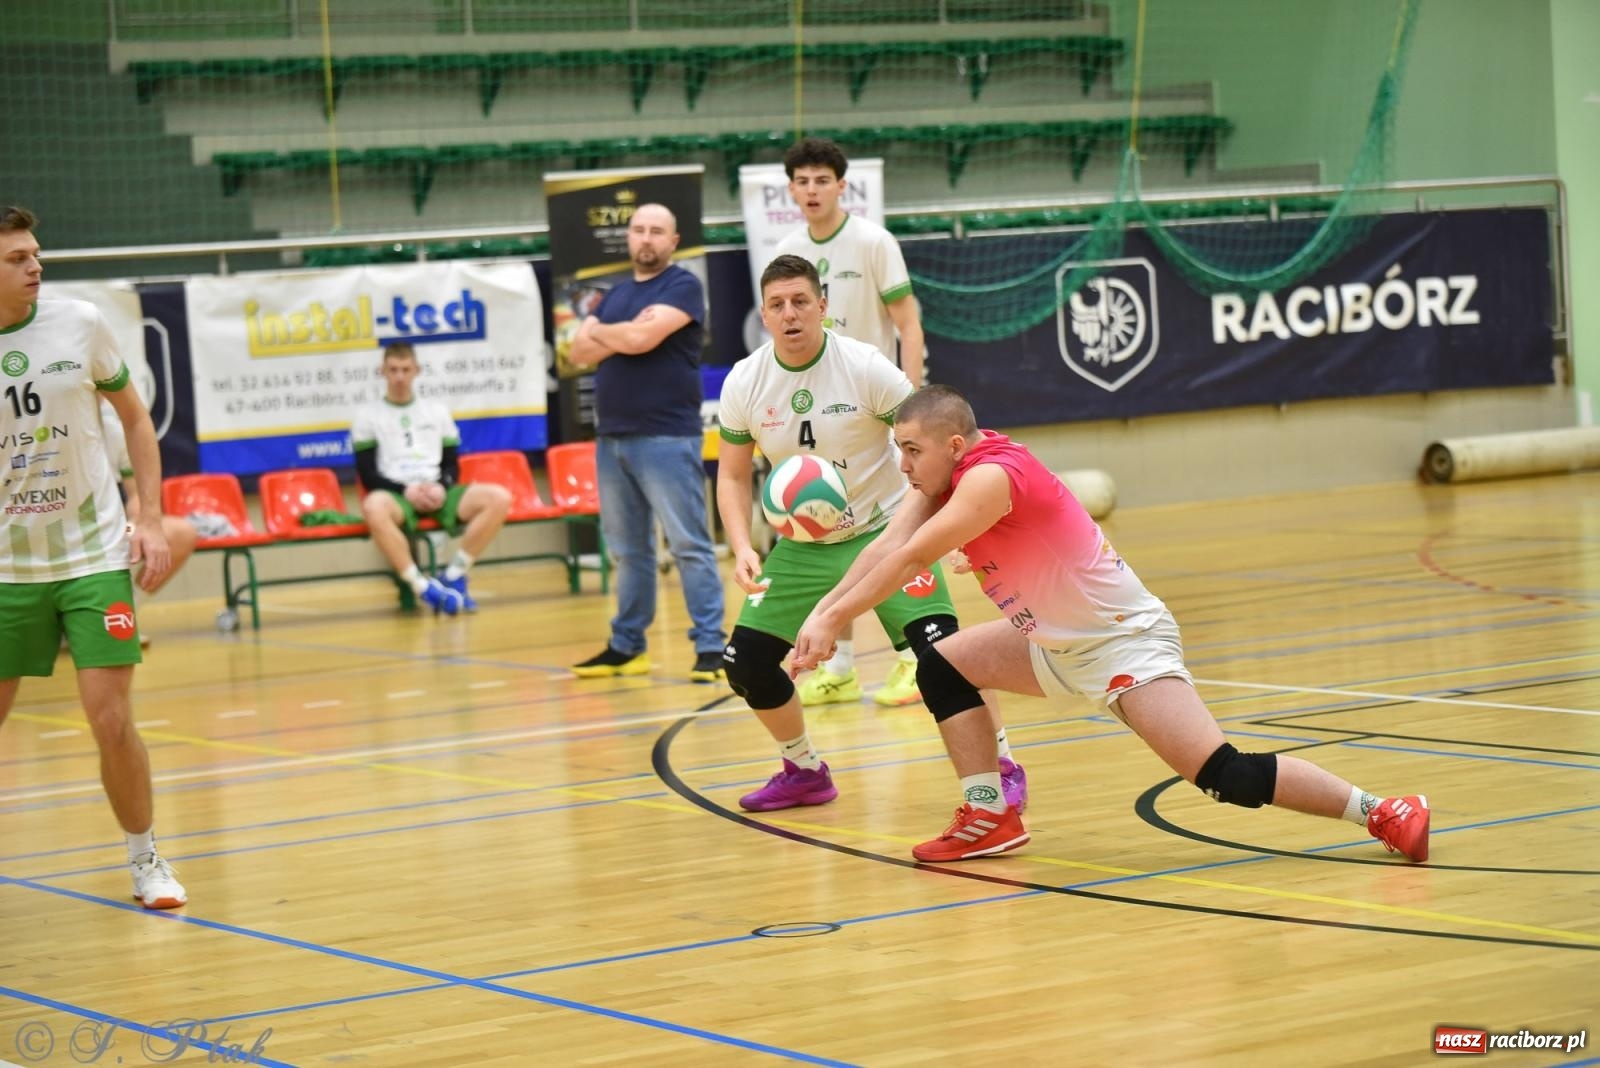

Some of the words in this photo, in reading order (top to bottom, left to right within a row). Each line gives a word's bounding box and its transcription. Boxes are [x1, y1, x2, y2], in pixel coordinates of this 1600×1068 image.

[1211, 263, 1480, 343] RACIBÓRZ
[244, 290, 486, 358] instal-tech
[4, 381, 41, 419] 16
[821, 405, 857, 415] AGROTEAM
[798, 420, 816, 450] 4
